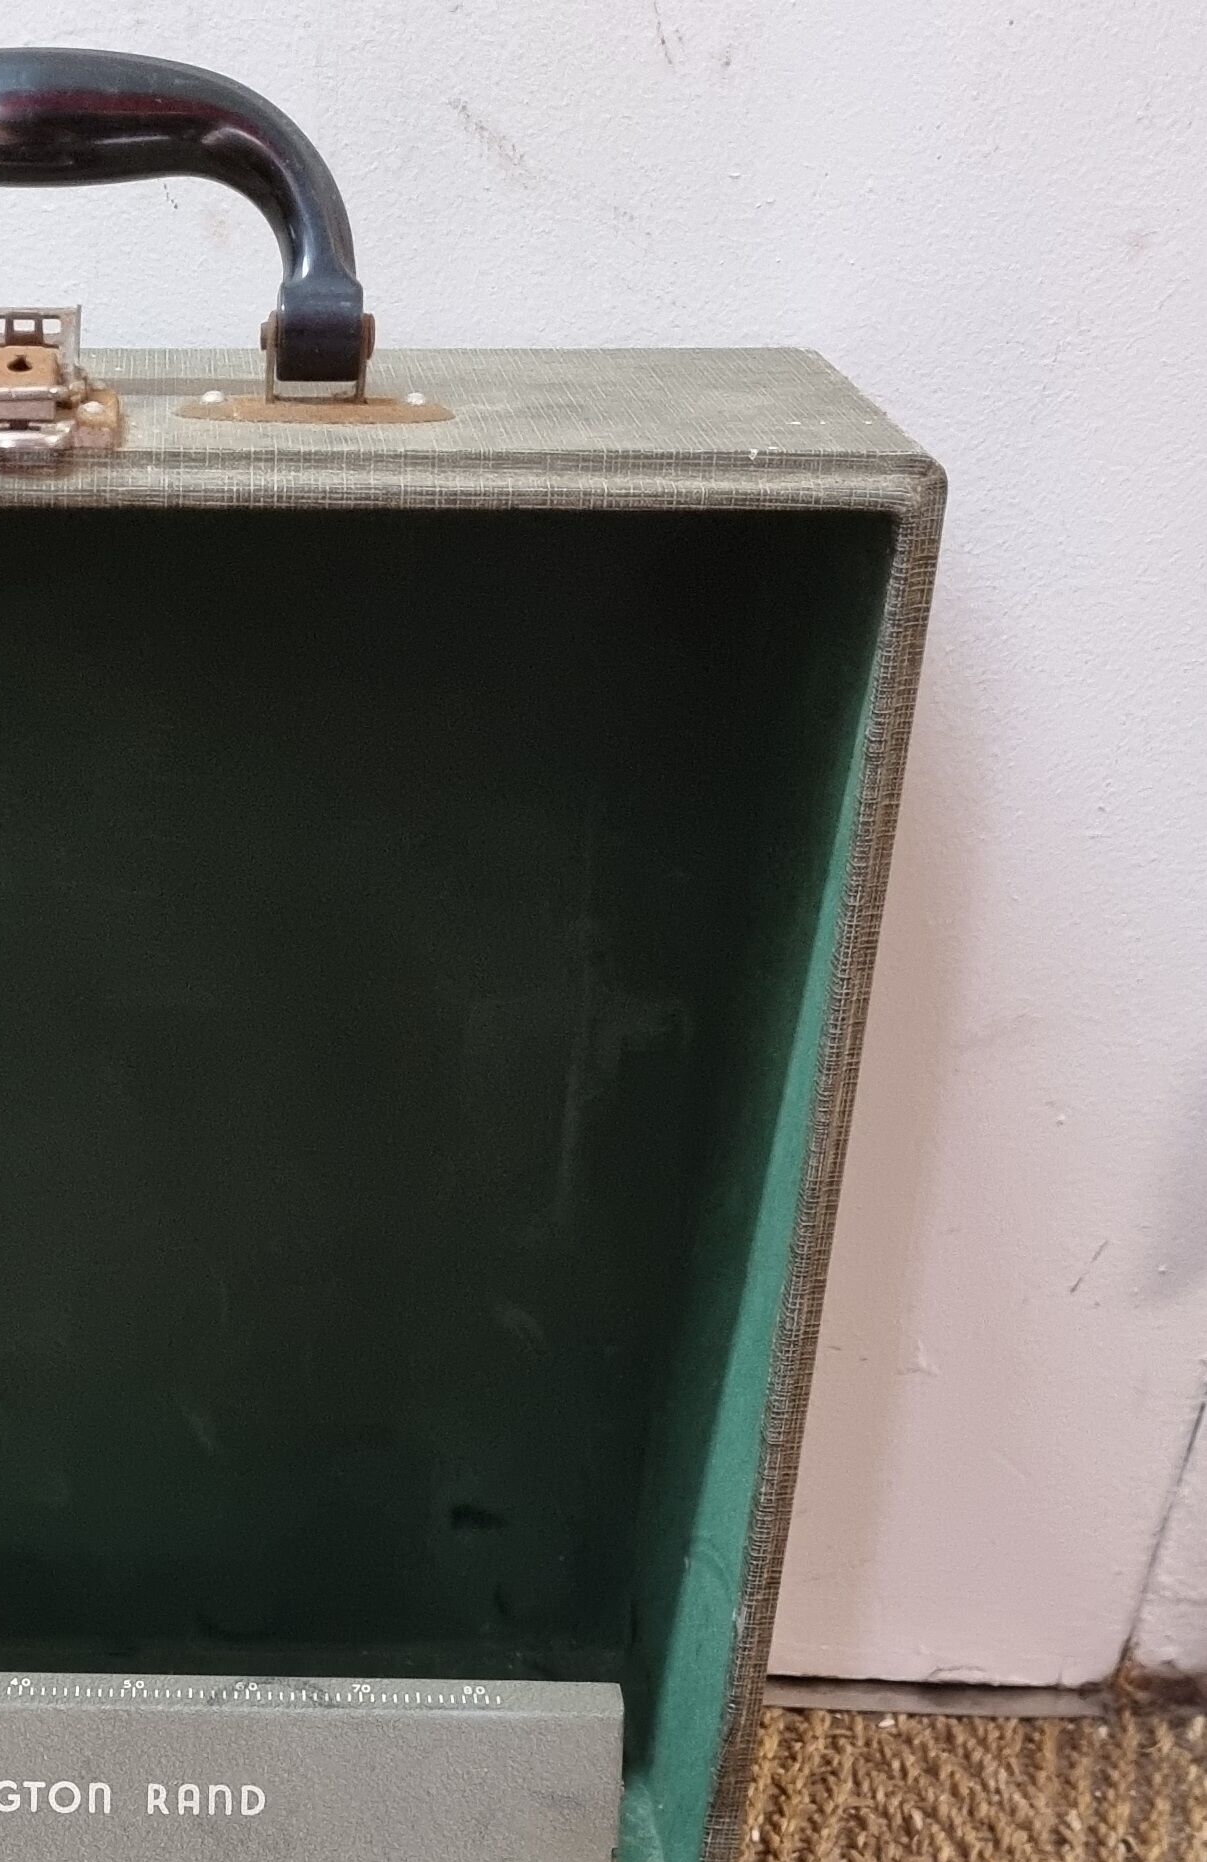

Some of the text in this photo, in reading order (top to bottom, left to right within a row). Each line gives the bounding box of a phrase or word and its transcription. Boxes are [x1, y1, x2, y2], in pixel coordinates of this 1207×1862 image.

[10, 1677, 32, 1687] 40
[351, 1684, 372, 1693] 70
[147, 1782, 266, 1816] RAND
